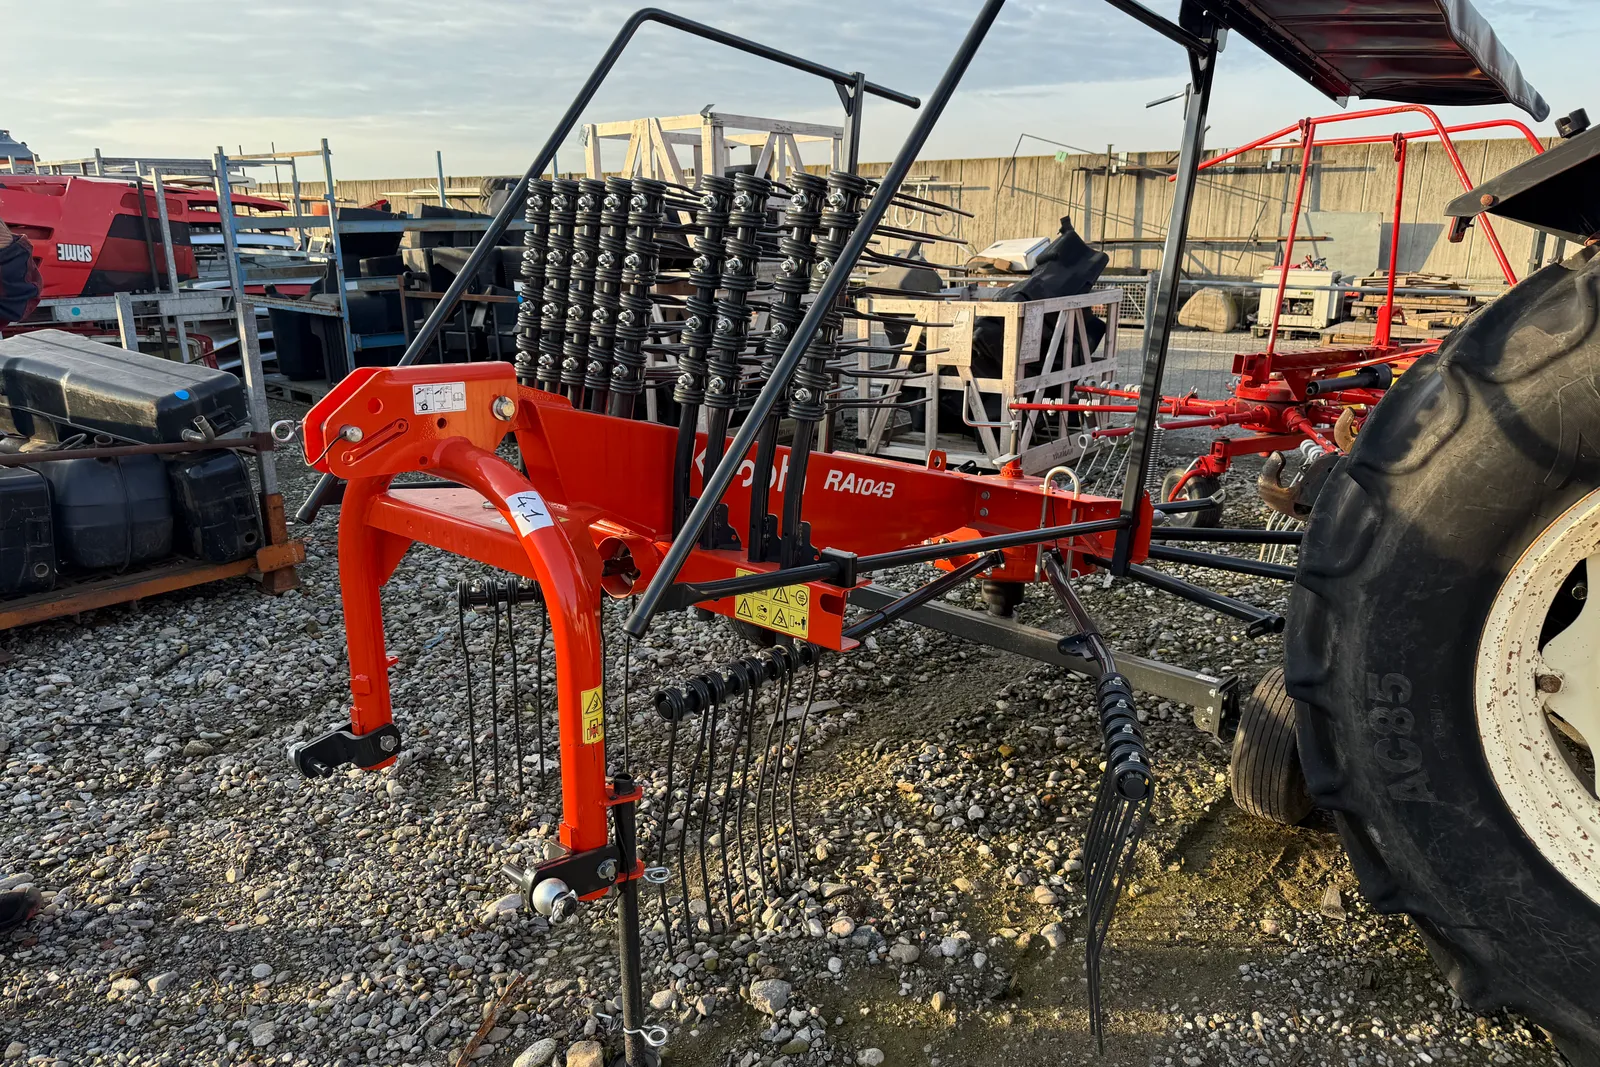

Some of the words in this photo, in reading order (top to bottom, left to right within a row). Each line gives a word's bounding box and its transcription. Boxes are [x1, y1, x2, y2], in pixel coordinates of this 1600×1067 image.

[57, 243, 92, 262] SAME
[824, 469, 896, 498] RA1043
[517, 496, 544, 523] 41
[1366, 672, 1439, 803] AC85
